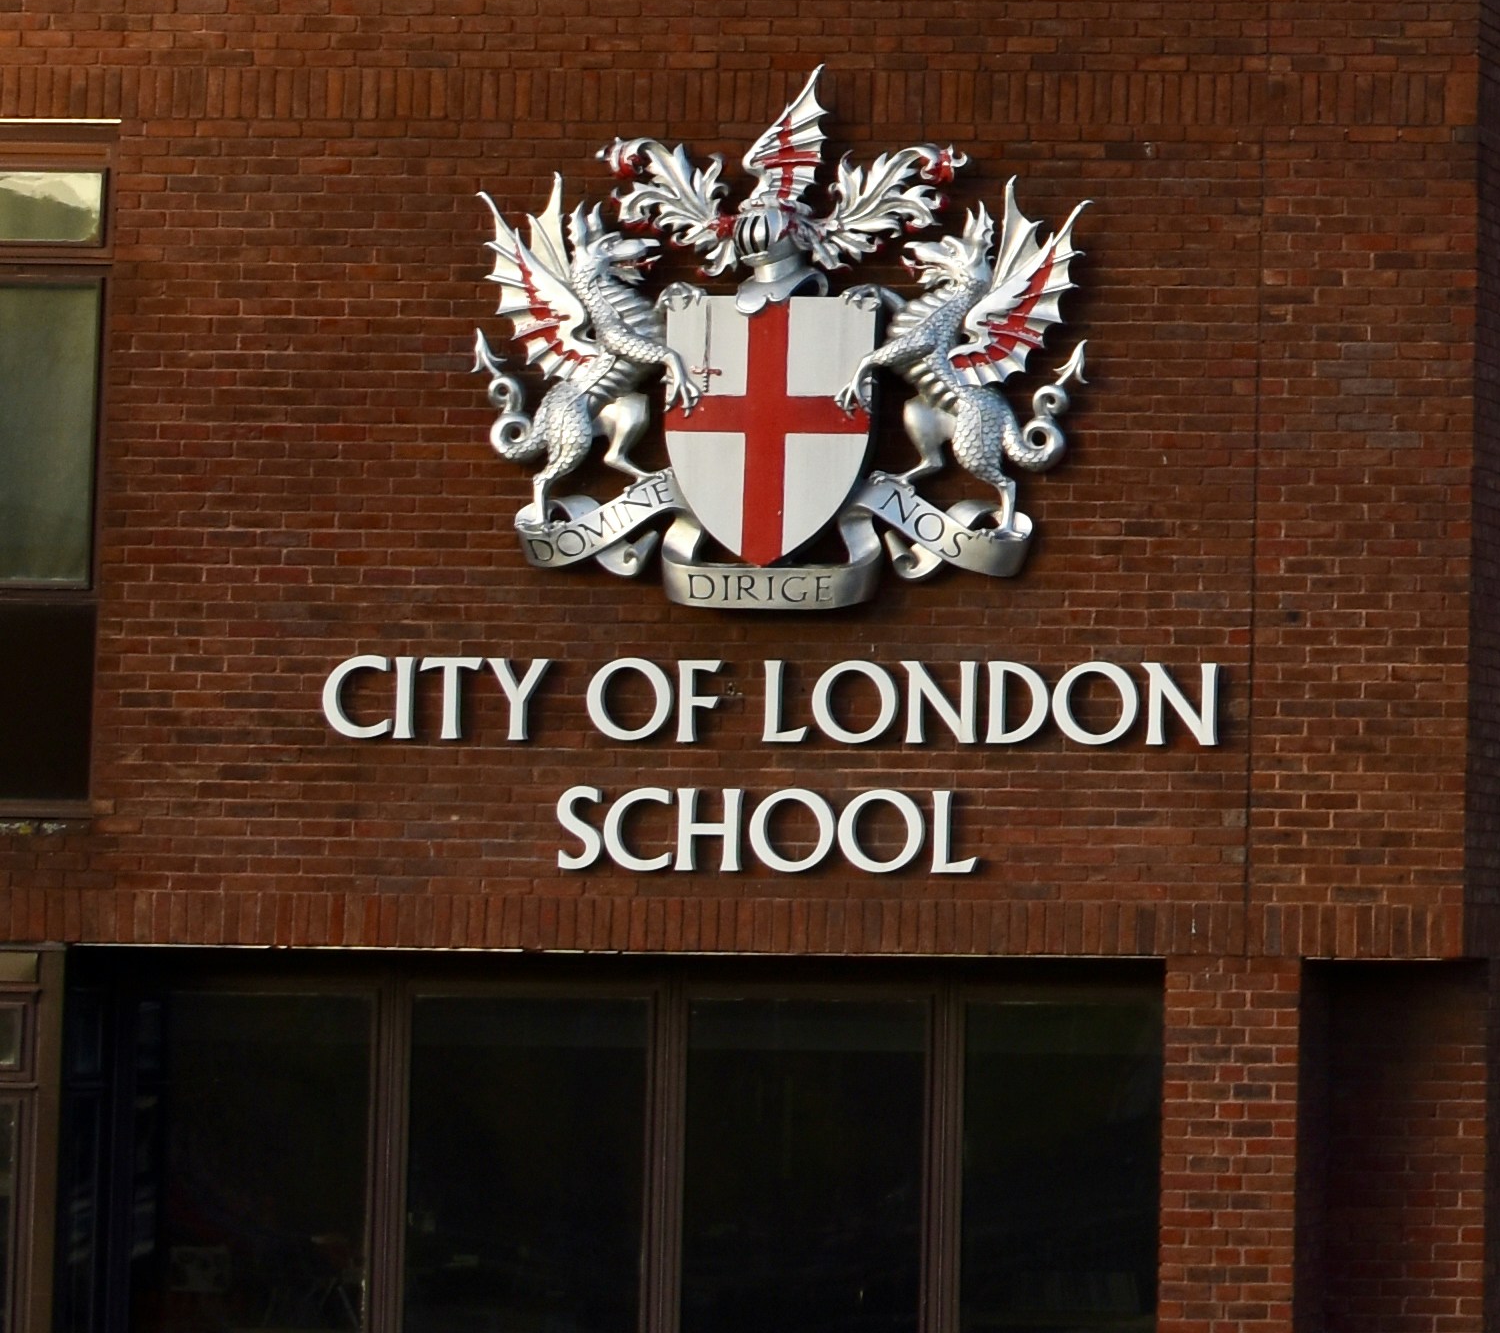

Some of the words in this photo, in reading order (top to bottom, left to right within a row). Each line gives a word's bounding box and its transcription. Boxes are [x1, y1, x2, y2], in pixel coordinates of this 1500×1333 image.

[526, 480, 675, 563] DOMINE
[687, 573, 834, 604] DIRIGE
[881, 488, 975, 560] NOS
[322, 655, 550, 741] CITY
[586, 658, 724, 743] OF
[761, 660, 1219, 747] LONDON
[556, 785, 979, 874] SCHOOL
